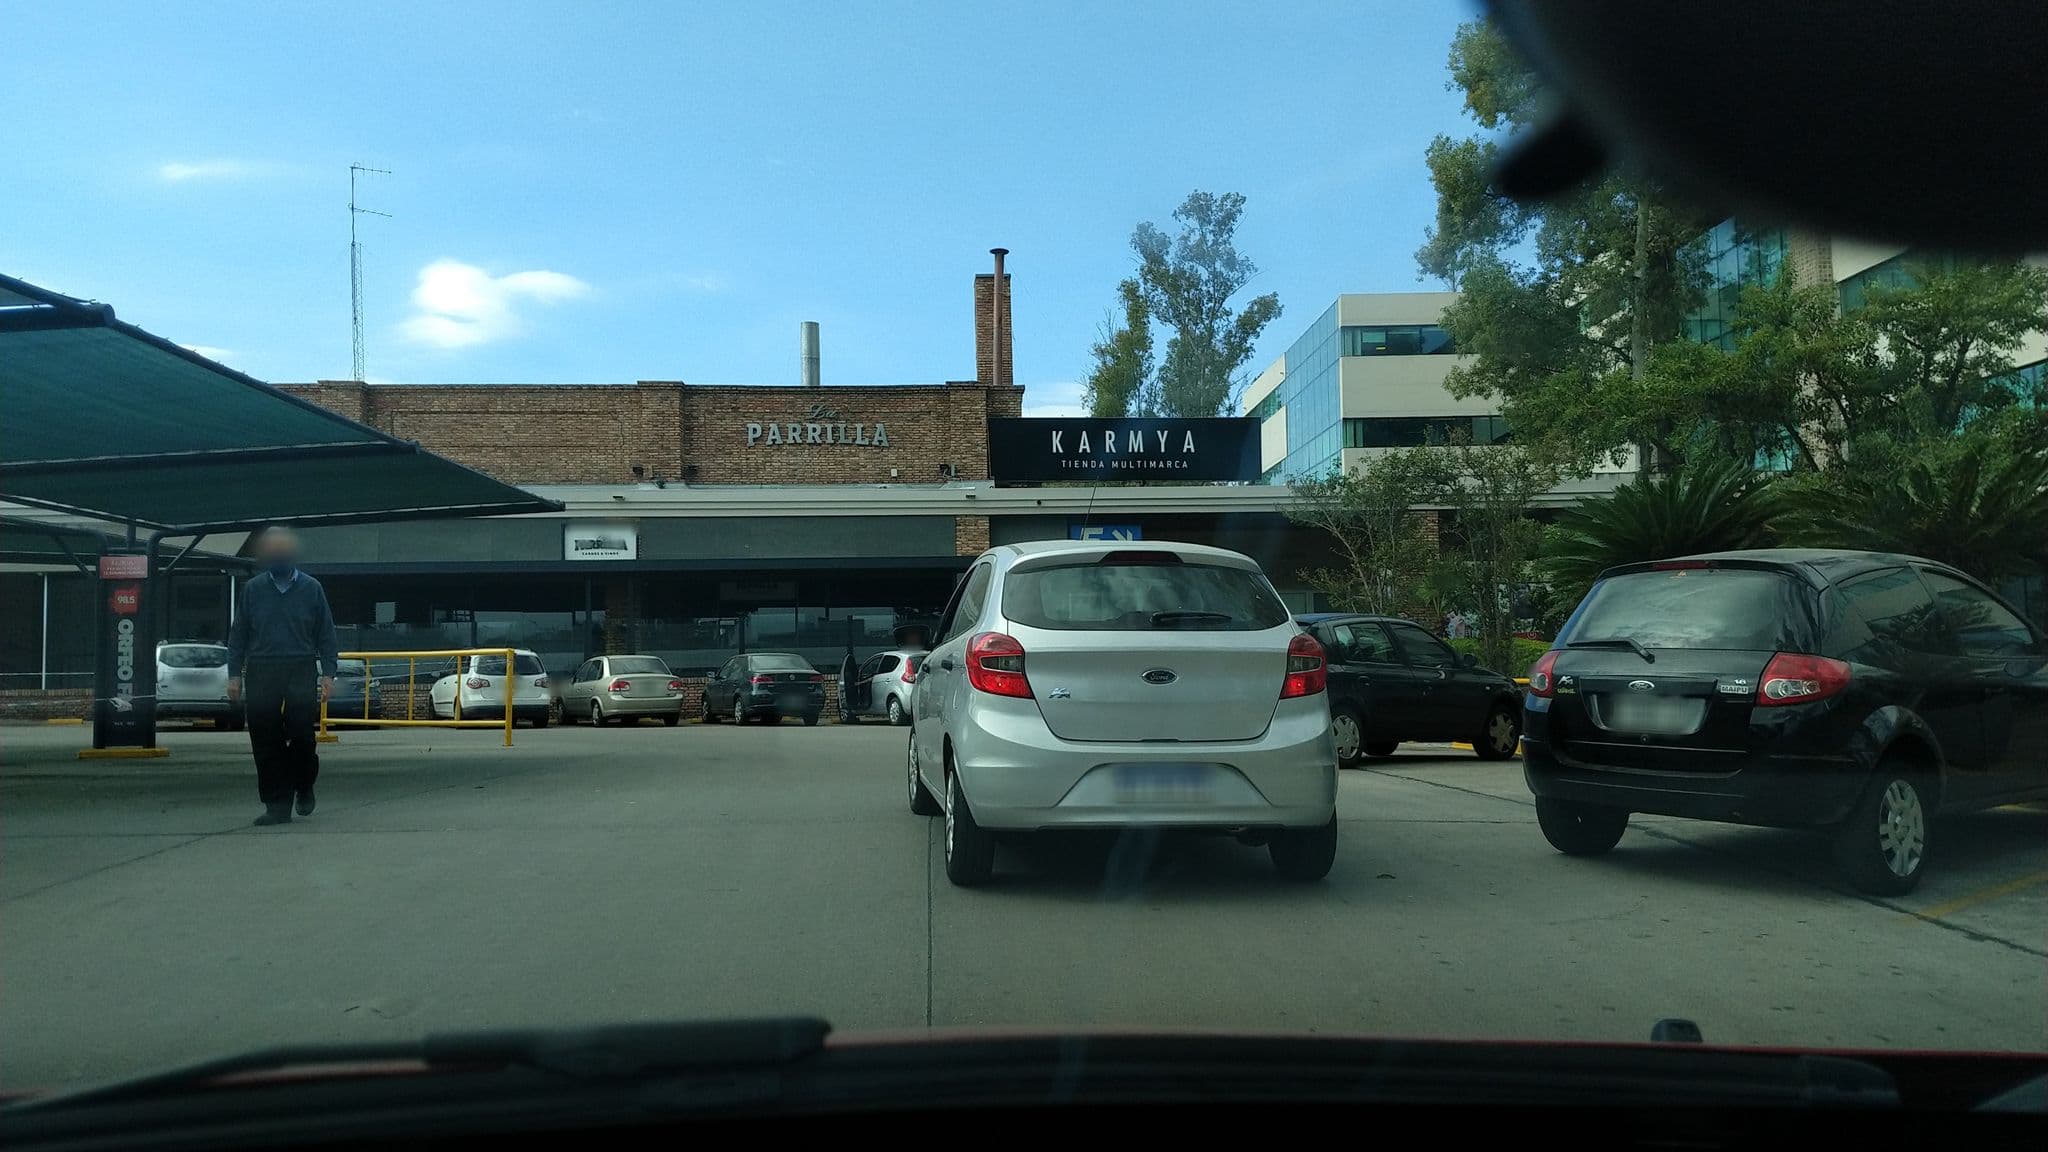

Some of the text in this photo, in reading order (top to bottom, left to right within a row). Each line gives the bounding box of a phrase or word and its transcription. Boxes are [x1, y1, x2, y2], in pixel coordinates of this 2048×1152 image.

[807, 403, 840, 419] La
[745, 422, 891, 448] PARRILLA
[1051, 429, 1196, 454] KARMYA
[1060, 460, 1189, 469] TIENDA MULTIMARCA
[117, 618, 134, 681] ORFEO
